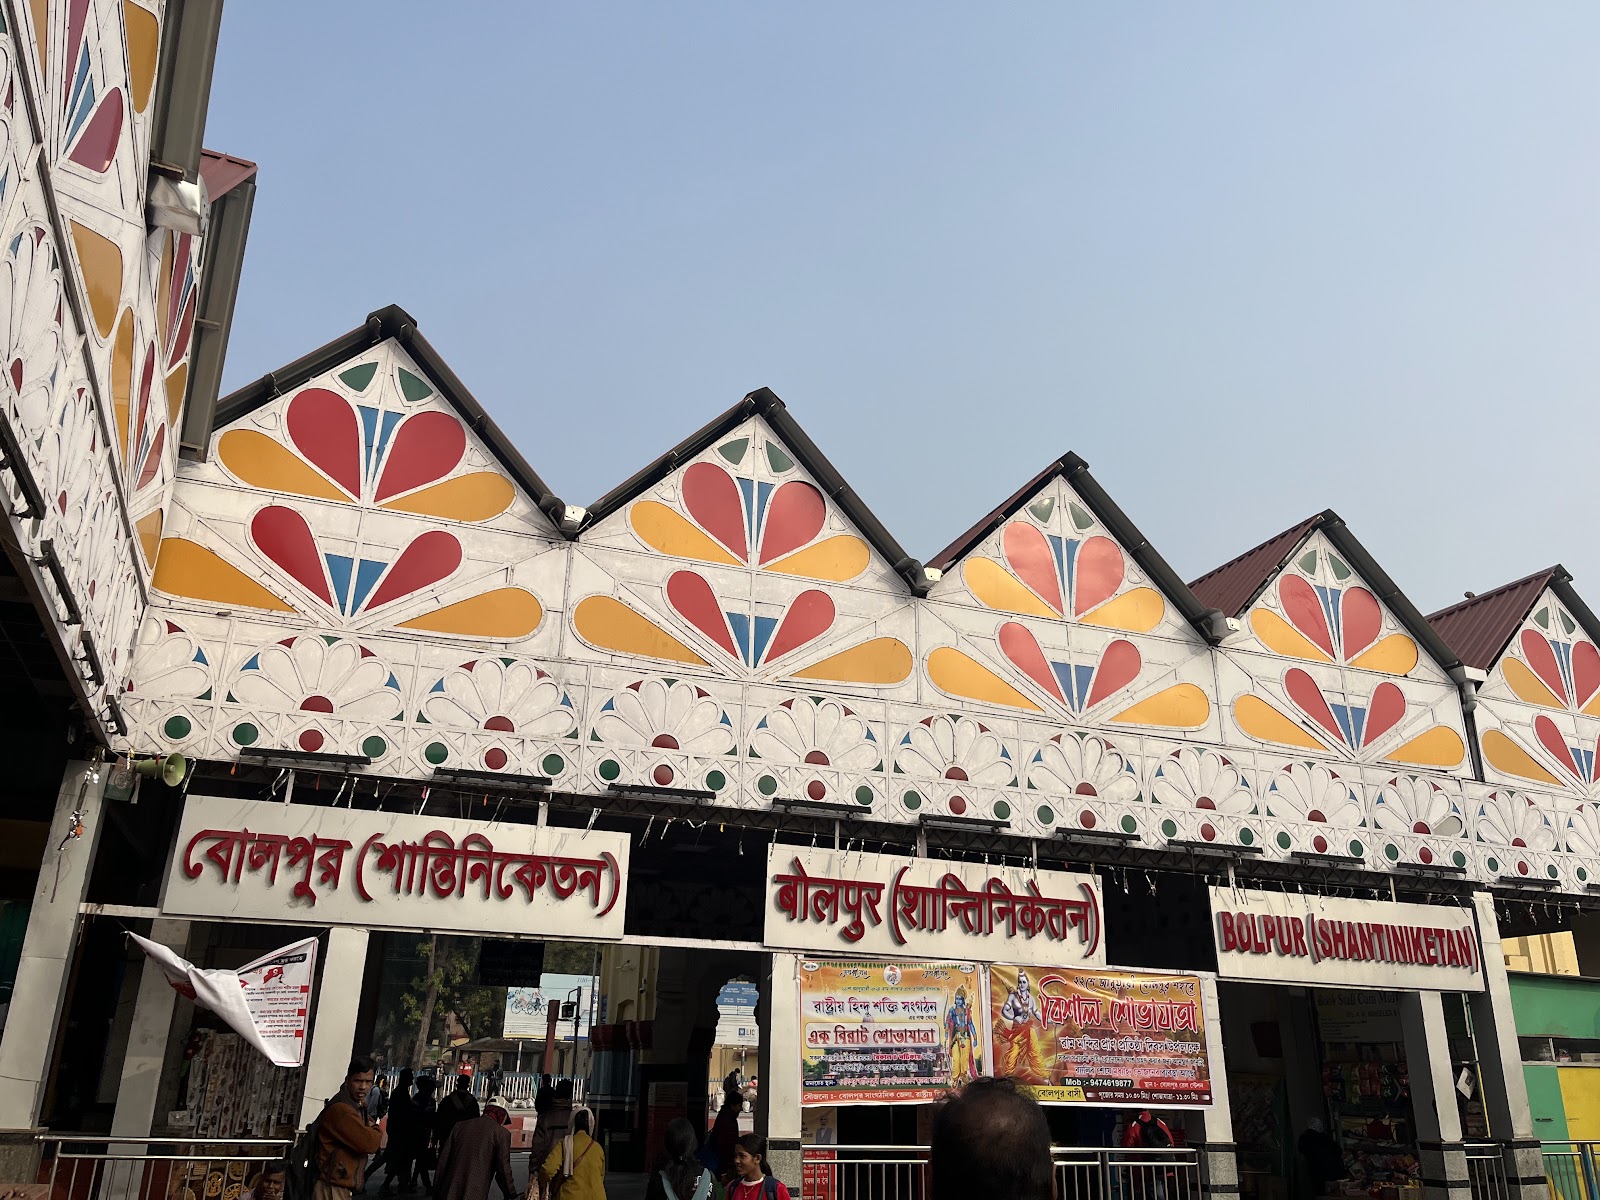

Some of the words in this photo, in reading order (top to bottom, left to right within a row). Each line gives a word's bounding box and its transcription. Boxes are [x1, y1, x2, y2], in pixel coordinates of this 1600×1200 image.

[183, 828, 352, 906] বোলপুর
[355, 829, 619, 917] (শান্তিনিকেতন)
[774, 856, 885, 941] बोलपुर
[891, 866, 1100, 957] (शान्तिनिकेतन)
[1216, 911, 1308, 957] BOLPUR
[1307, 913, 1478, 973] (SHANTINIKETAN)
[1074, 976, 1096, 992] ২২শে
[1139, 981, 1169, 996] বোলপুর
[1172, 981, 1196, 996] শহরে
[812, 996, 845, 1017] রাষ্ট্রীয়
[848, 996, 871, 1017] হিন্দু
[872, 997, 899, 1014] শক্তি
[901, 996, 937, 1014] সংগঠন
[1038, 974, 1102, 1030] বিশাল
[1110, 996, 1199, 1034] শোভাযাত্রা
[808, 1029, 831, 1044] এক
[833, 1024, 869, 1045] বিরাট
[873, 1028, 936, 1045] শোভাযাত্রা
[1059, 1036, 1076, 1049] রাম
[1076, 1034, 1100, 1050] মন্দির
[1100, 1038, 1117, 1051] প্রাণ
[1118, 1036, 1144, 1052] প্রতিষ্ঠা
[1144, 1036, 1165, 1053] দিবস
[1066, 1078, 1081, 1086] Mob
[1090, 1079, 1131, 1087] 9474619877
[839, 1092, 863, 1101] বোলপুর
[1038, 1088, 1065, 1100] বোলপুর
[1067, 1088, 1081, 1098] বাসী
